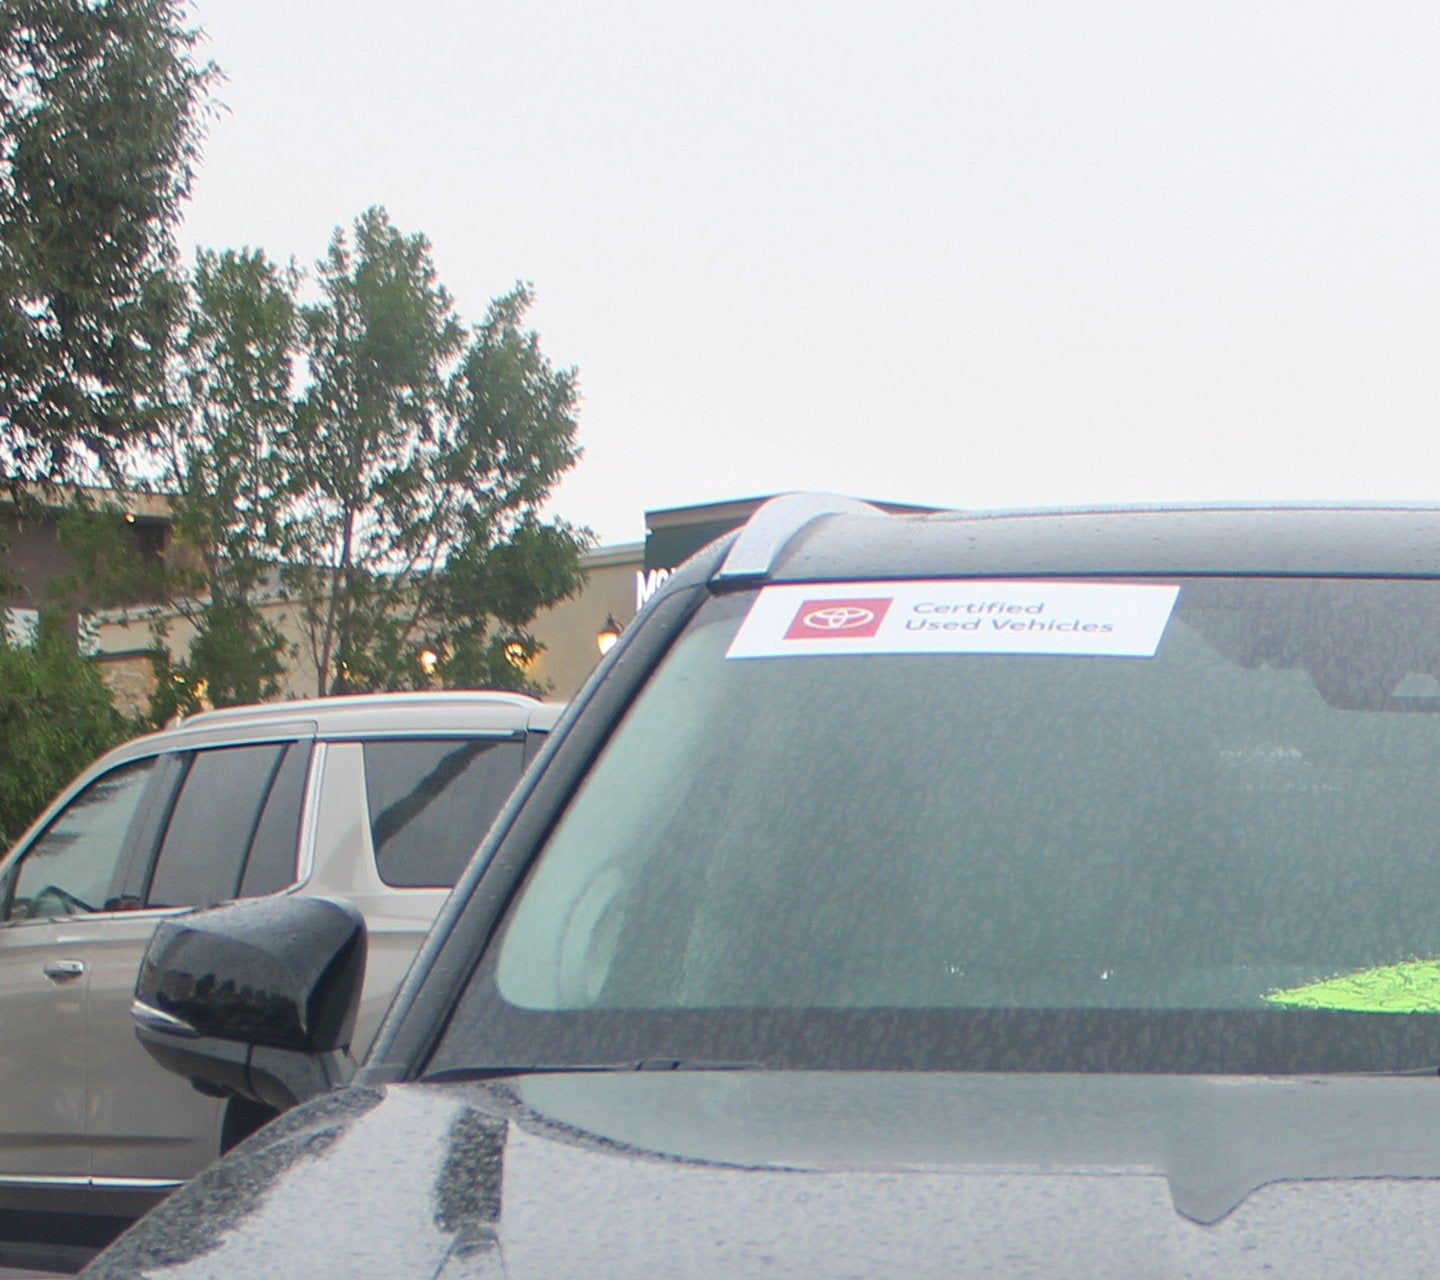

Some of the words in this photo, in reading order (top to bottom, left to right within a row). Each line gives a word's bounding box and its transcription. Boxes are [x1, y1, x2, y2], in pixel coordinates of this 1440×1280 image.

[913, 601, 1045, 614] Certified
[905, 618, 982, 631] Used
[992, 618, 1114, 632] Vehicles
